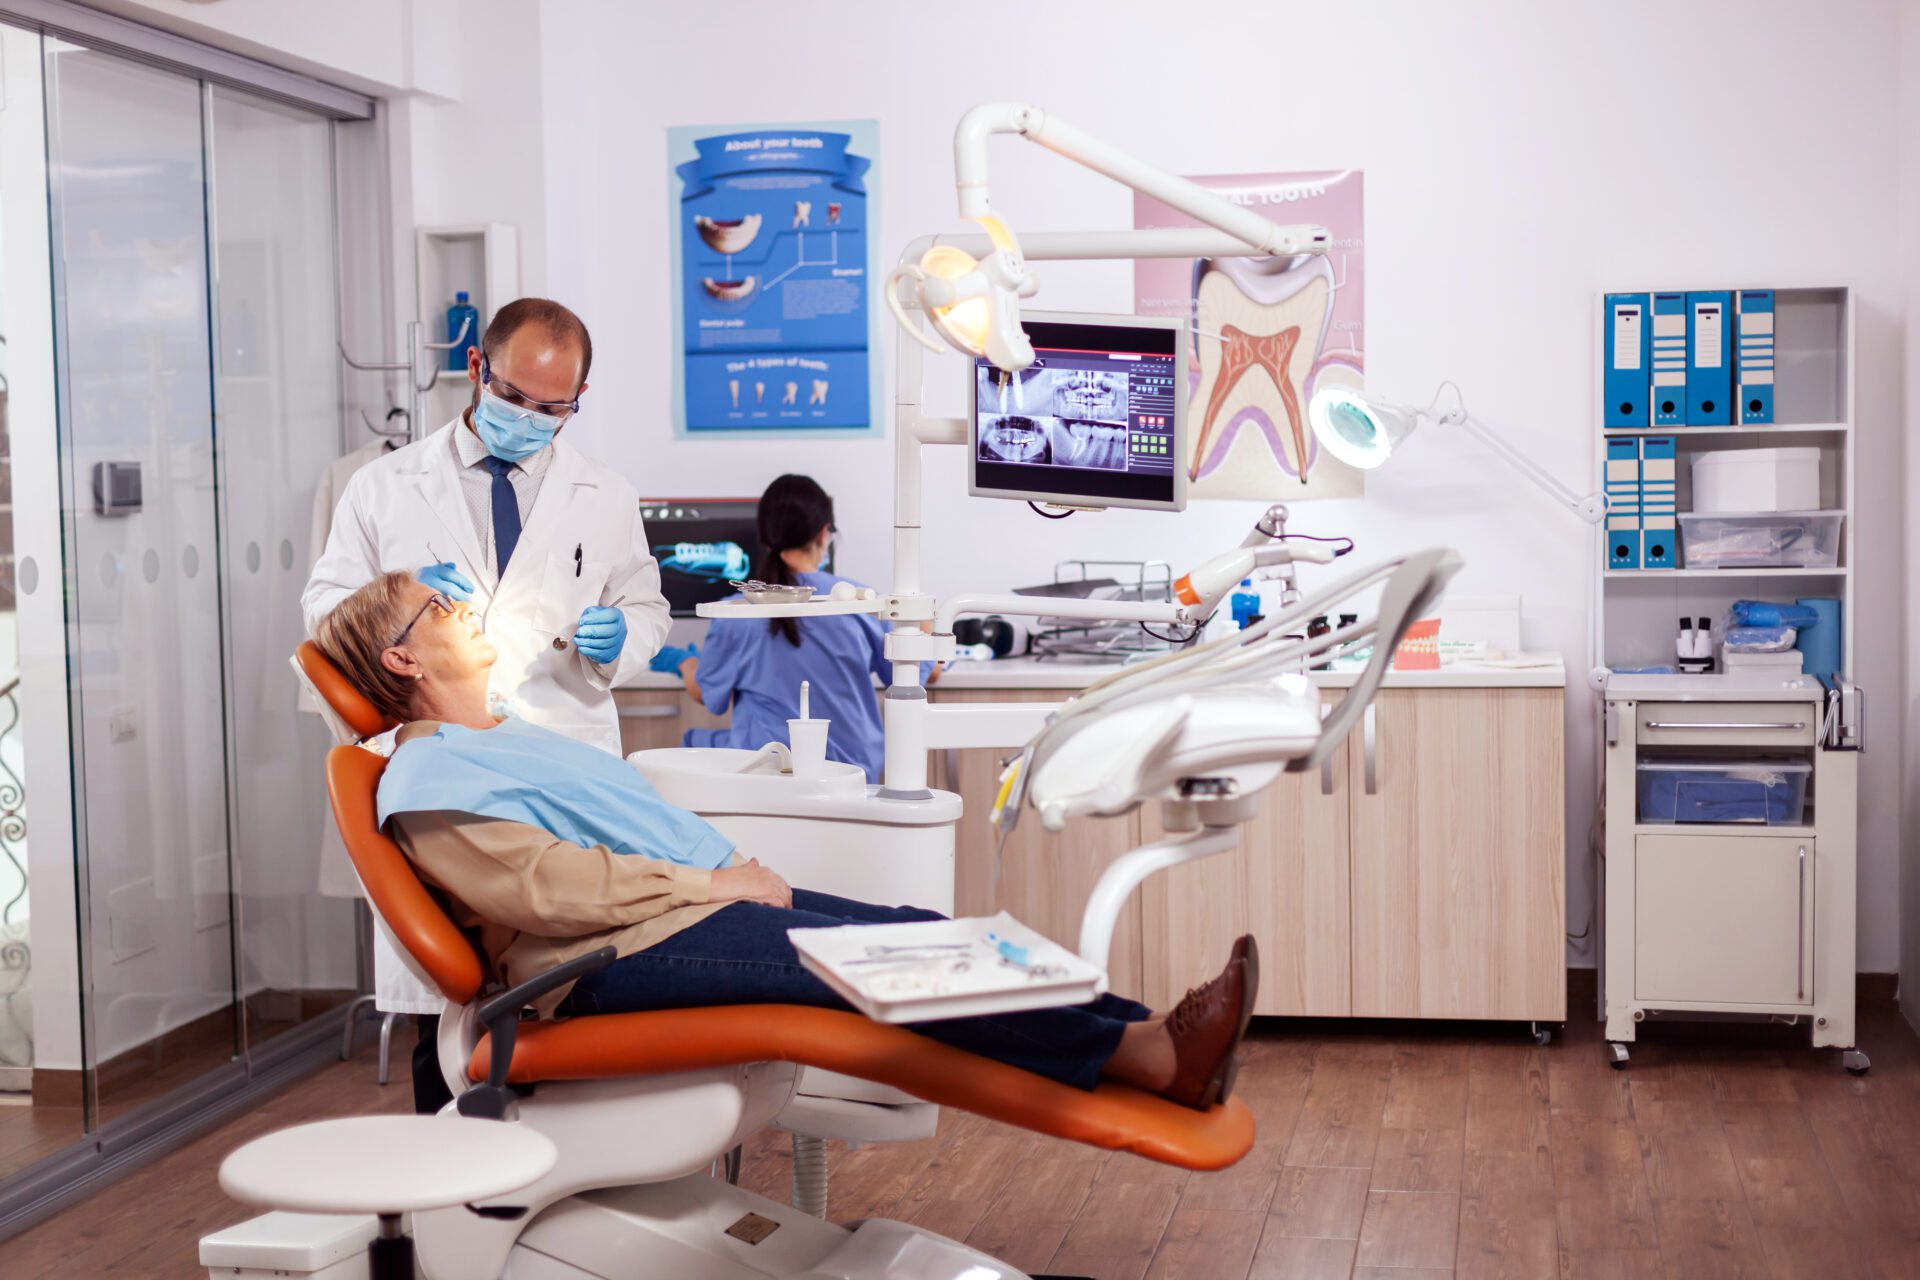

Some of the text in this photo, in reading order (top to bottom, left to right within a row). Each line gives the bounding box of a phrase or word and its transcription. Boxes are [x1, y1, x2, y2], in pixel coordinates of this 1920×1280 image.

[725, 137, 824, 151] About your teeth
[1260, 184, 1326, 205] TOOTH
[1333, 319, 1362, 331] Gum
